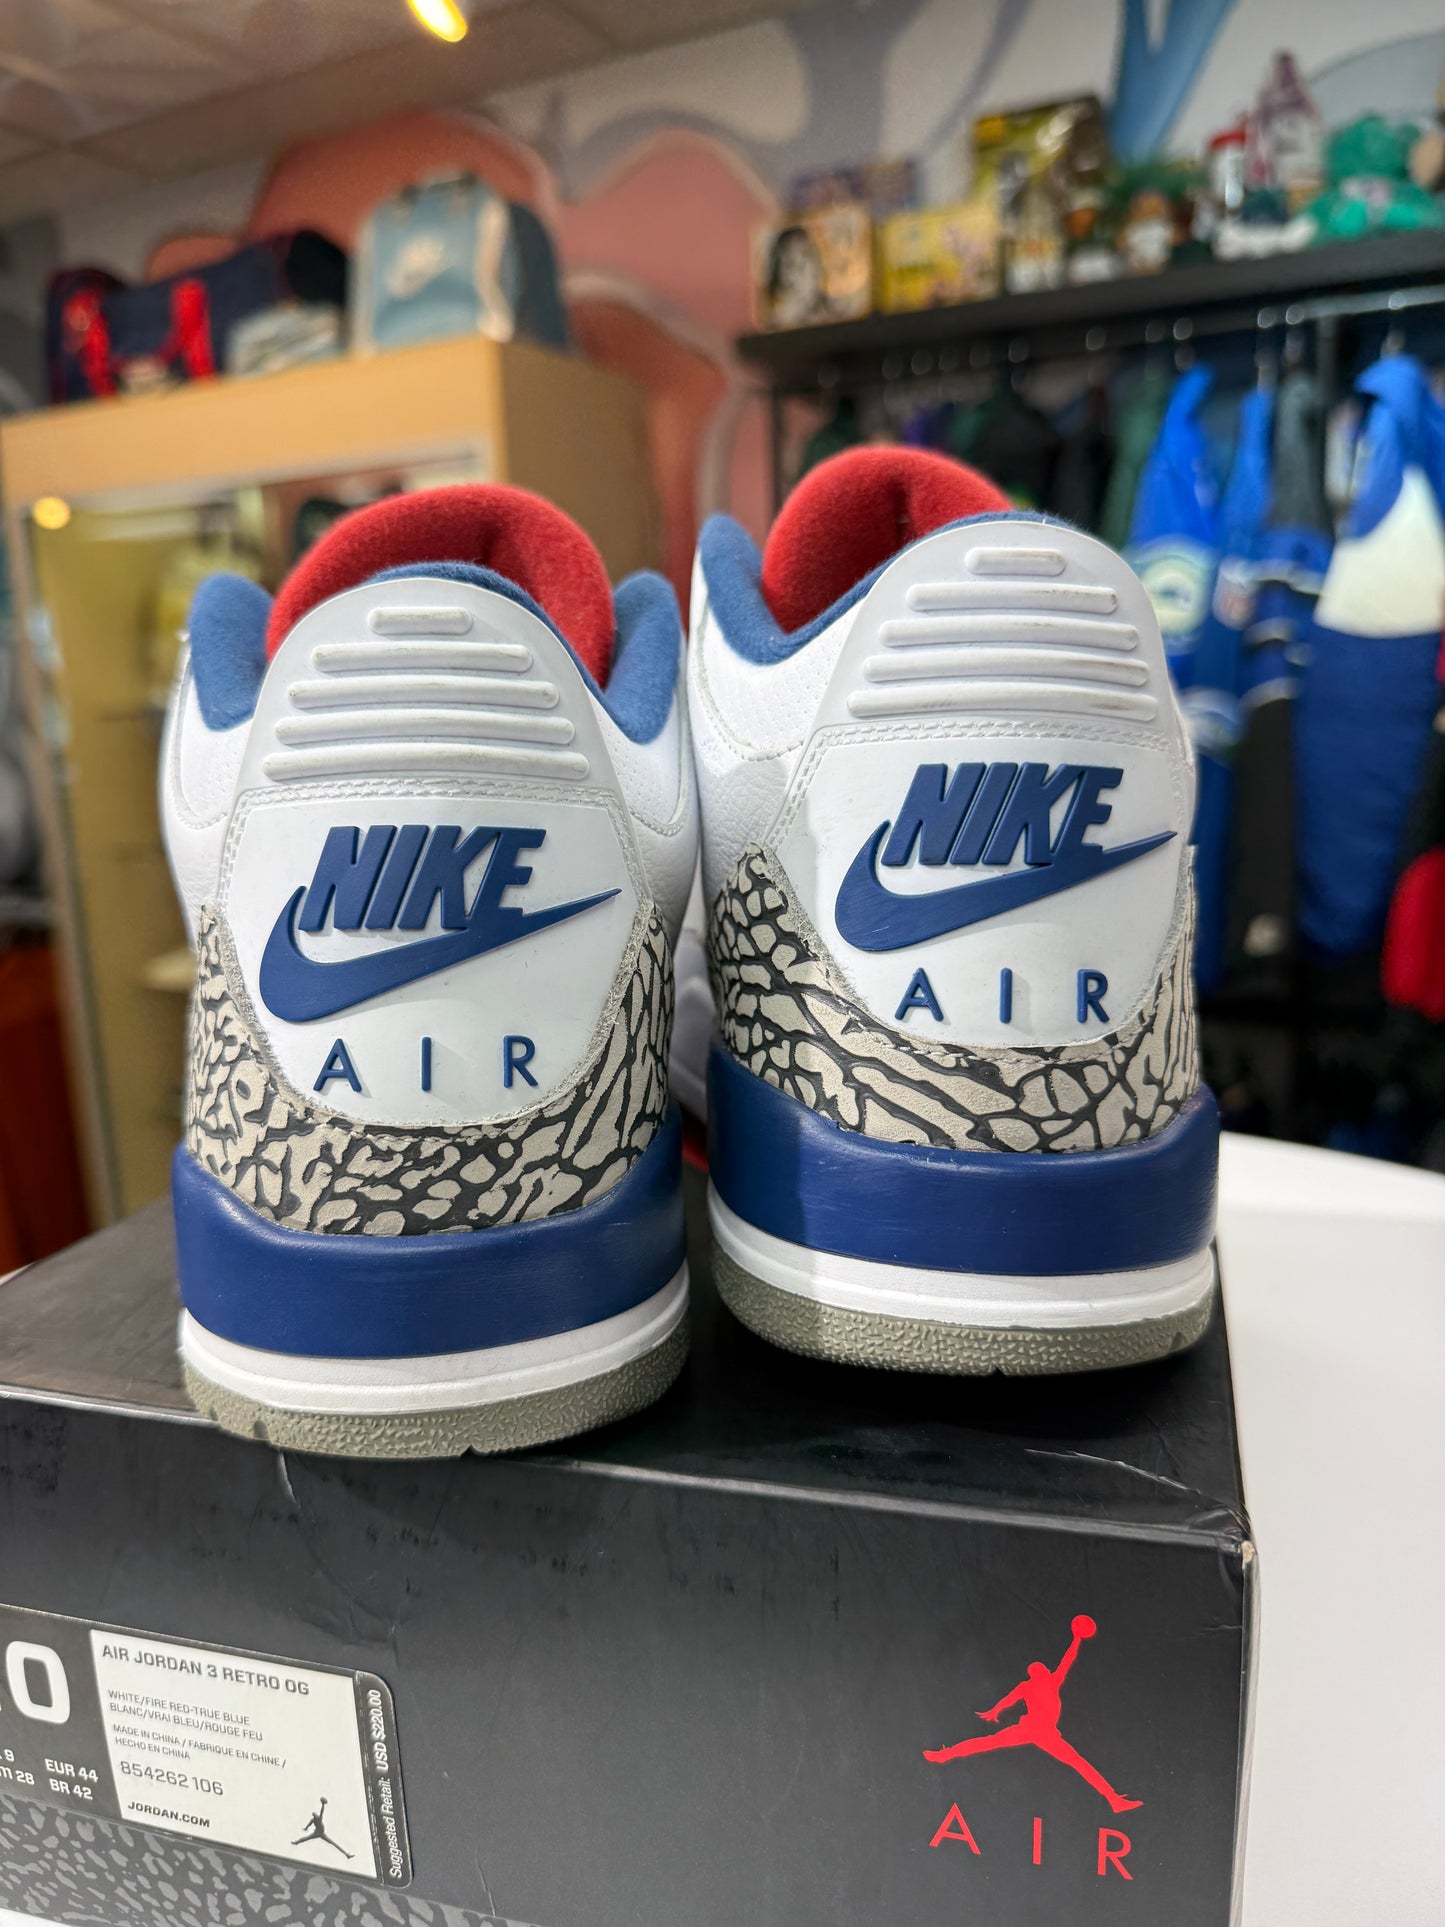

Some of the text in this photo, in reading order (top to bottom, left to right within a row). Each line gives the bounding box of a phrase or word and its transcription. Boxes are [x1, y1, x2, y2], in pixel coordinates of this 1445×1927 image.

[881, 762, 1124, 866] NIKE
[298, 824, 546, 930] NIKE
[894, 967, 1110, 1024] AIR
[313, 1034, 538, 1092] AIR
[102, 1644, 310, 1696] AIR JORDAN 3 RETRO OG
[108, 1689, 250, 1726] WHITE/FIRE RED-TRUE BLUE
[109, 1702, 263, 1742] BLANC/VRAI BLEU/ROUGE FEU
[4, 1749, 15, 1762] 9
[113, 1724, 139, 1737] MADE
[141, 1729, 150, 1738] IN
[152, 1731, 180, 1746] CHINA
[188, 1739, 234, 1756] FABRIQUE
[236, 1749, 249, 1760] EN
[250, 1752, 280, 1766] CHINE
[115, 1737, 191, 1760] HECHO EN CHINA
[16, 1770, 35, 1785] 28
[44, 1758, 99, 1783] EUR 44
[49, 1778, 93, 1800] BR 42
[367, 1689, 404, 1879] Suggested Retail: USD $220.00
[128, 1801, 210, 1828] JORDAN.COM
[929, 1802, 1133, 1881] AIR
